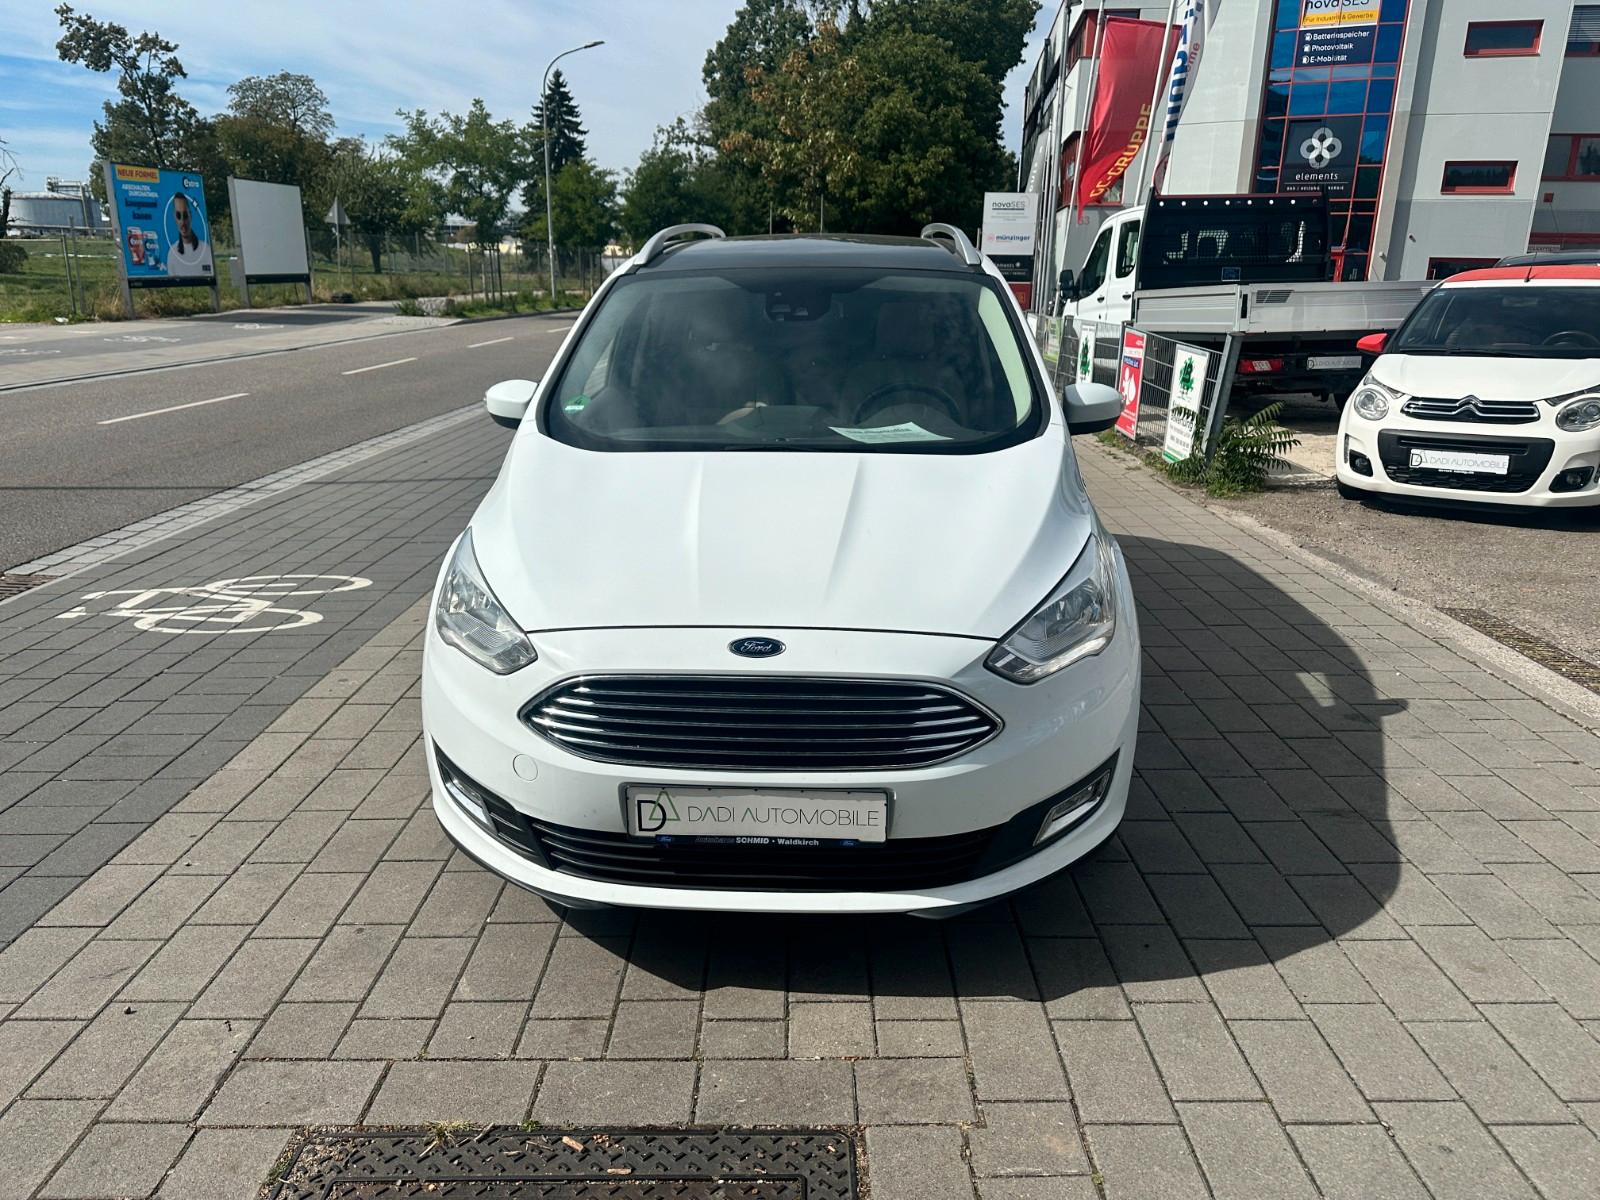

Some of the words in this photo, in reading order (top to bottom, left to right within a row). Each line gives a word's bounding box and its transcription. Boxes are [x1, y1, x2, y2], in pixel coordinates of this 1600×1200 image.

[1348, 12, 1374, 20] Gewerbe
[1311, 43, 1354, 52] Photovoltaik
[1310, 55, 1347, 63] E-Mobilität
[1295, 172, 1339, 181] elements
[1451, 458, 1507, 468] AUTOMOBILE
[740, 640, 773, 652] Ford
[687, 805, 736, 823] DADI
[740, 807, 880, 828] AUTOMOBILE
[735, 837, 770, 845] SCHMID
[777, 838, 820, 846] Waldkirch
